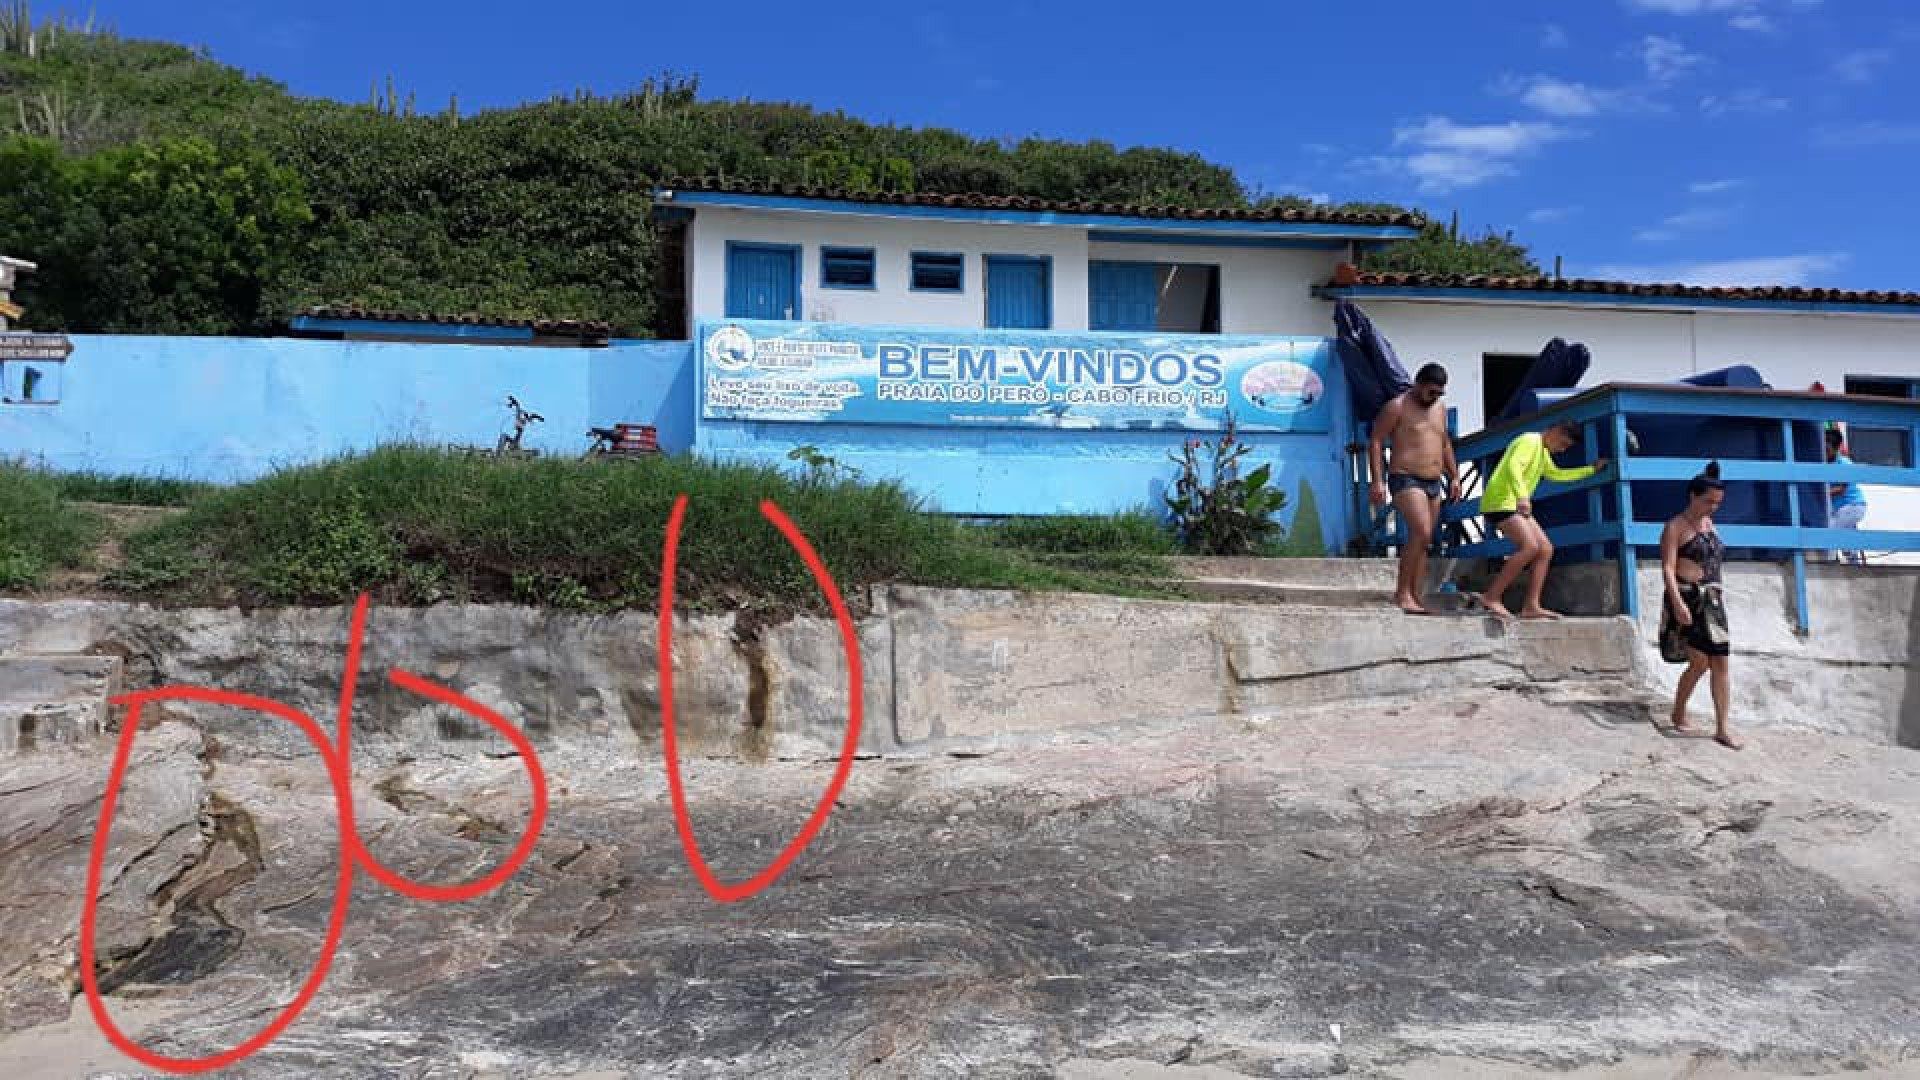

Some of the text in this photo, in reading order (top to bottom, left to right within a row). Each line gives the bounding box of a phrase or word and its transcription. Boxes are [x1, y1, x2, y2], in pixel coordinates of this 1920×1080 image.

[880, 346, 1223, 386] BEM-VINDOS
[879, 384, 945, 401] PRAIA
[953, 385, 984, 401] DO
[1069, 389, 1127, 403] CABO
[1135, 390, 1183, 405] FRIO
[1201, 391, 1226, 405] RJ
